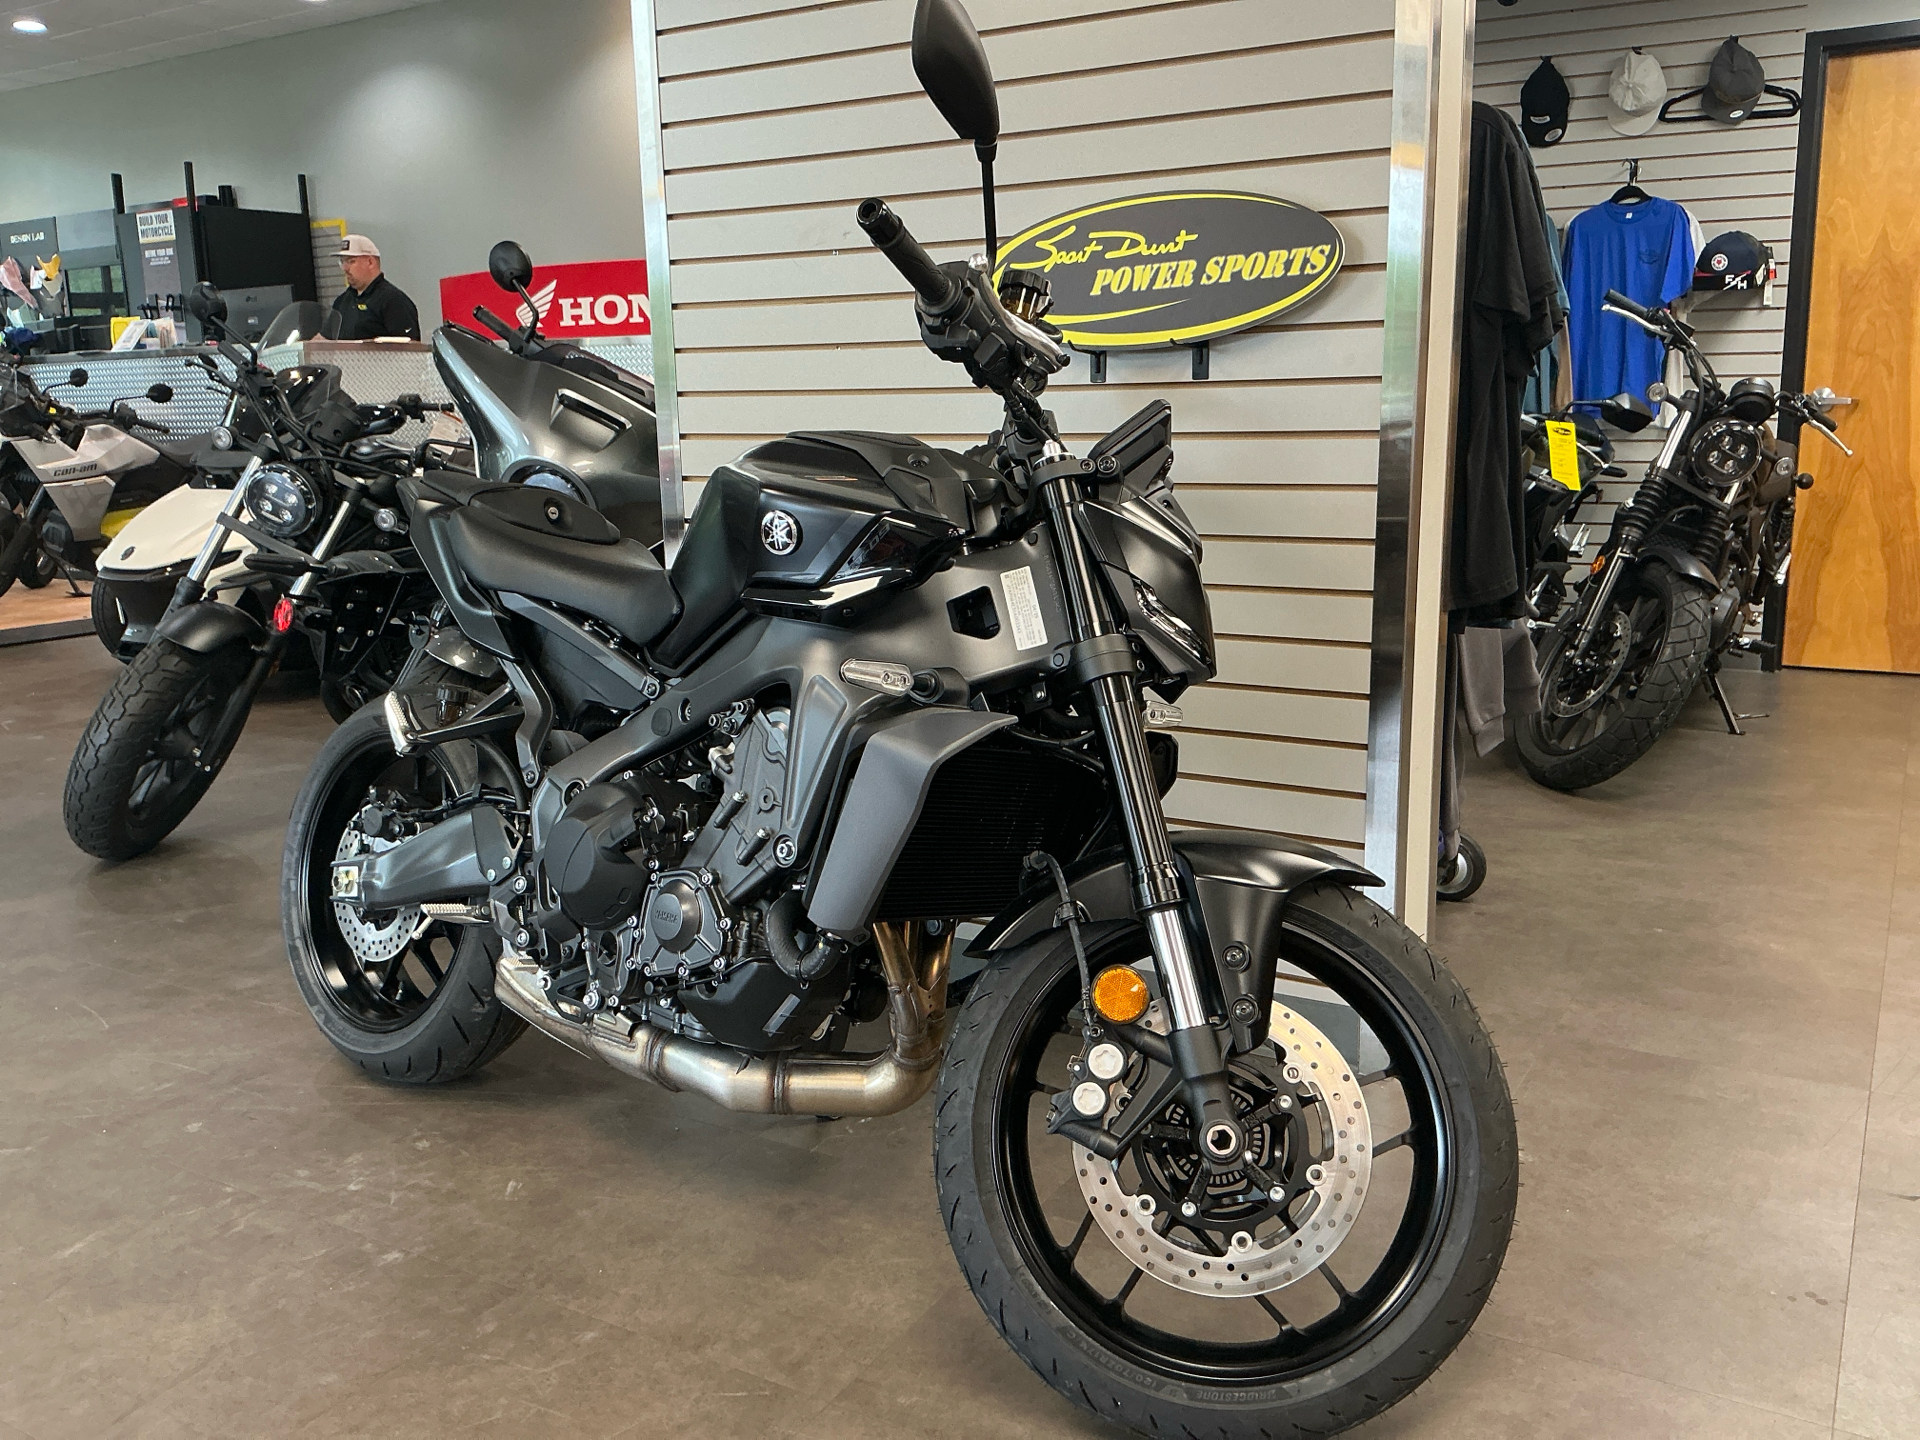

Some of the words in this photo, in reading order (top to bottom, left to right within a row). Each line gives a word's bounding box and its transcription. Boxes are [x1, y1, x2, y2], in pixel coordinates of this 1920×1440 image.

[138, 215, 154, 227] BUILD
[154, 212, 169, 225] YOUR
[140, 224, 174, 239] MOTORCYCLE
[1090, 260, 1198, 297] POWER
[1200, 243, 1332, 286] SPORTS
[53, 462, 98, 477] can-am
